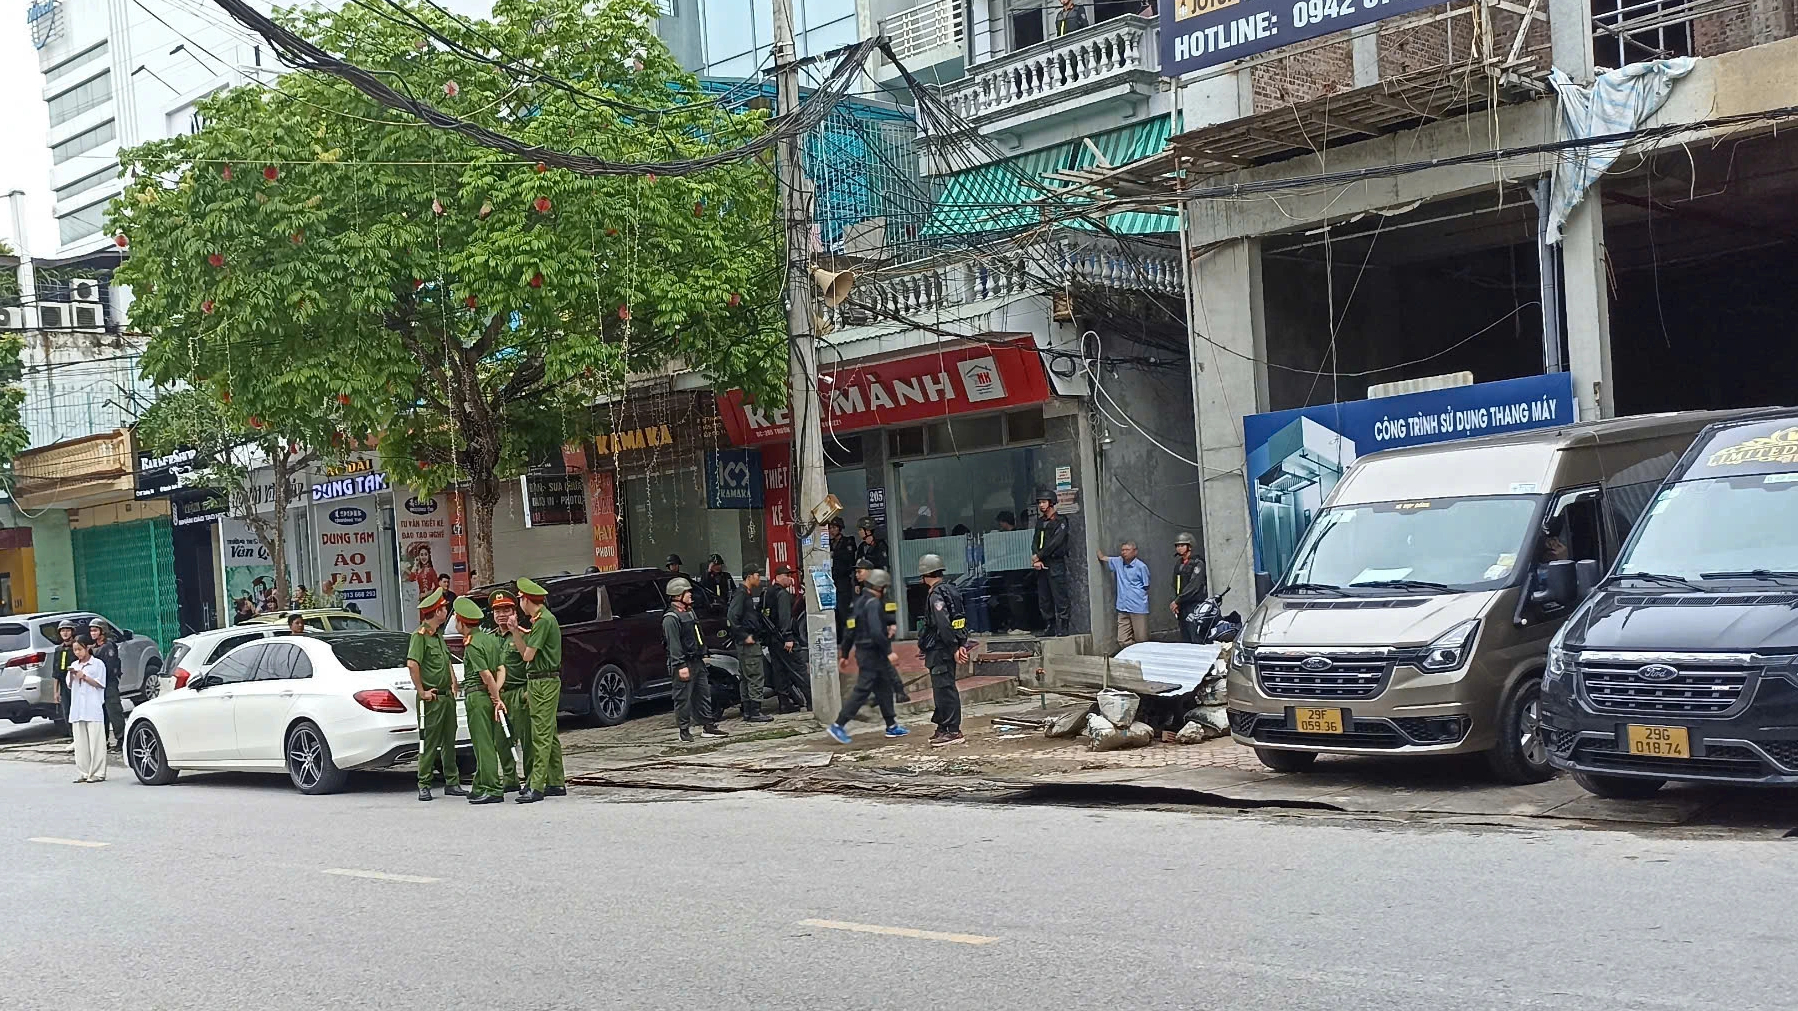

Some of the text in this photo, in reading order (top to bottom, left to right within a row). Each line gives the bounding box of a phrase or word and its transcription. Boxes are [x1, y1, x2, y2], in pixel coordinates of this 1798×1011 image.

[1174, 0, 1355, 61] HOTLINE: 0942
[830, 372, 956, 416] MÀNH
[1374, 395, 1557, 441] CÔNG TRÌNH SỬ DỤNG THANG MÁY
[595, 424, 674, 455] KAMAKA
[764, 463, 788, 489] THIẾT
[312, 479, 353, 500] DUNG
[719, 489, 751, 499] KAMAKA
[869, 490, 883, 502] 205
[771, 499, 785, 526] KẾ
[322, 532, 351, 545] DUNG
[773, 542, 787, 563] THI
[1644, 667, 1668, 678] Ford
[1308, 709, 1327, 720] 29F
[1301, 720, 1338, 732] 059.36
[1645, 727, 1671, 741] 29G
[1635, 740, 1682, 755] 018.74
